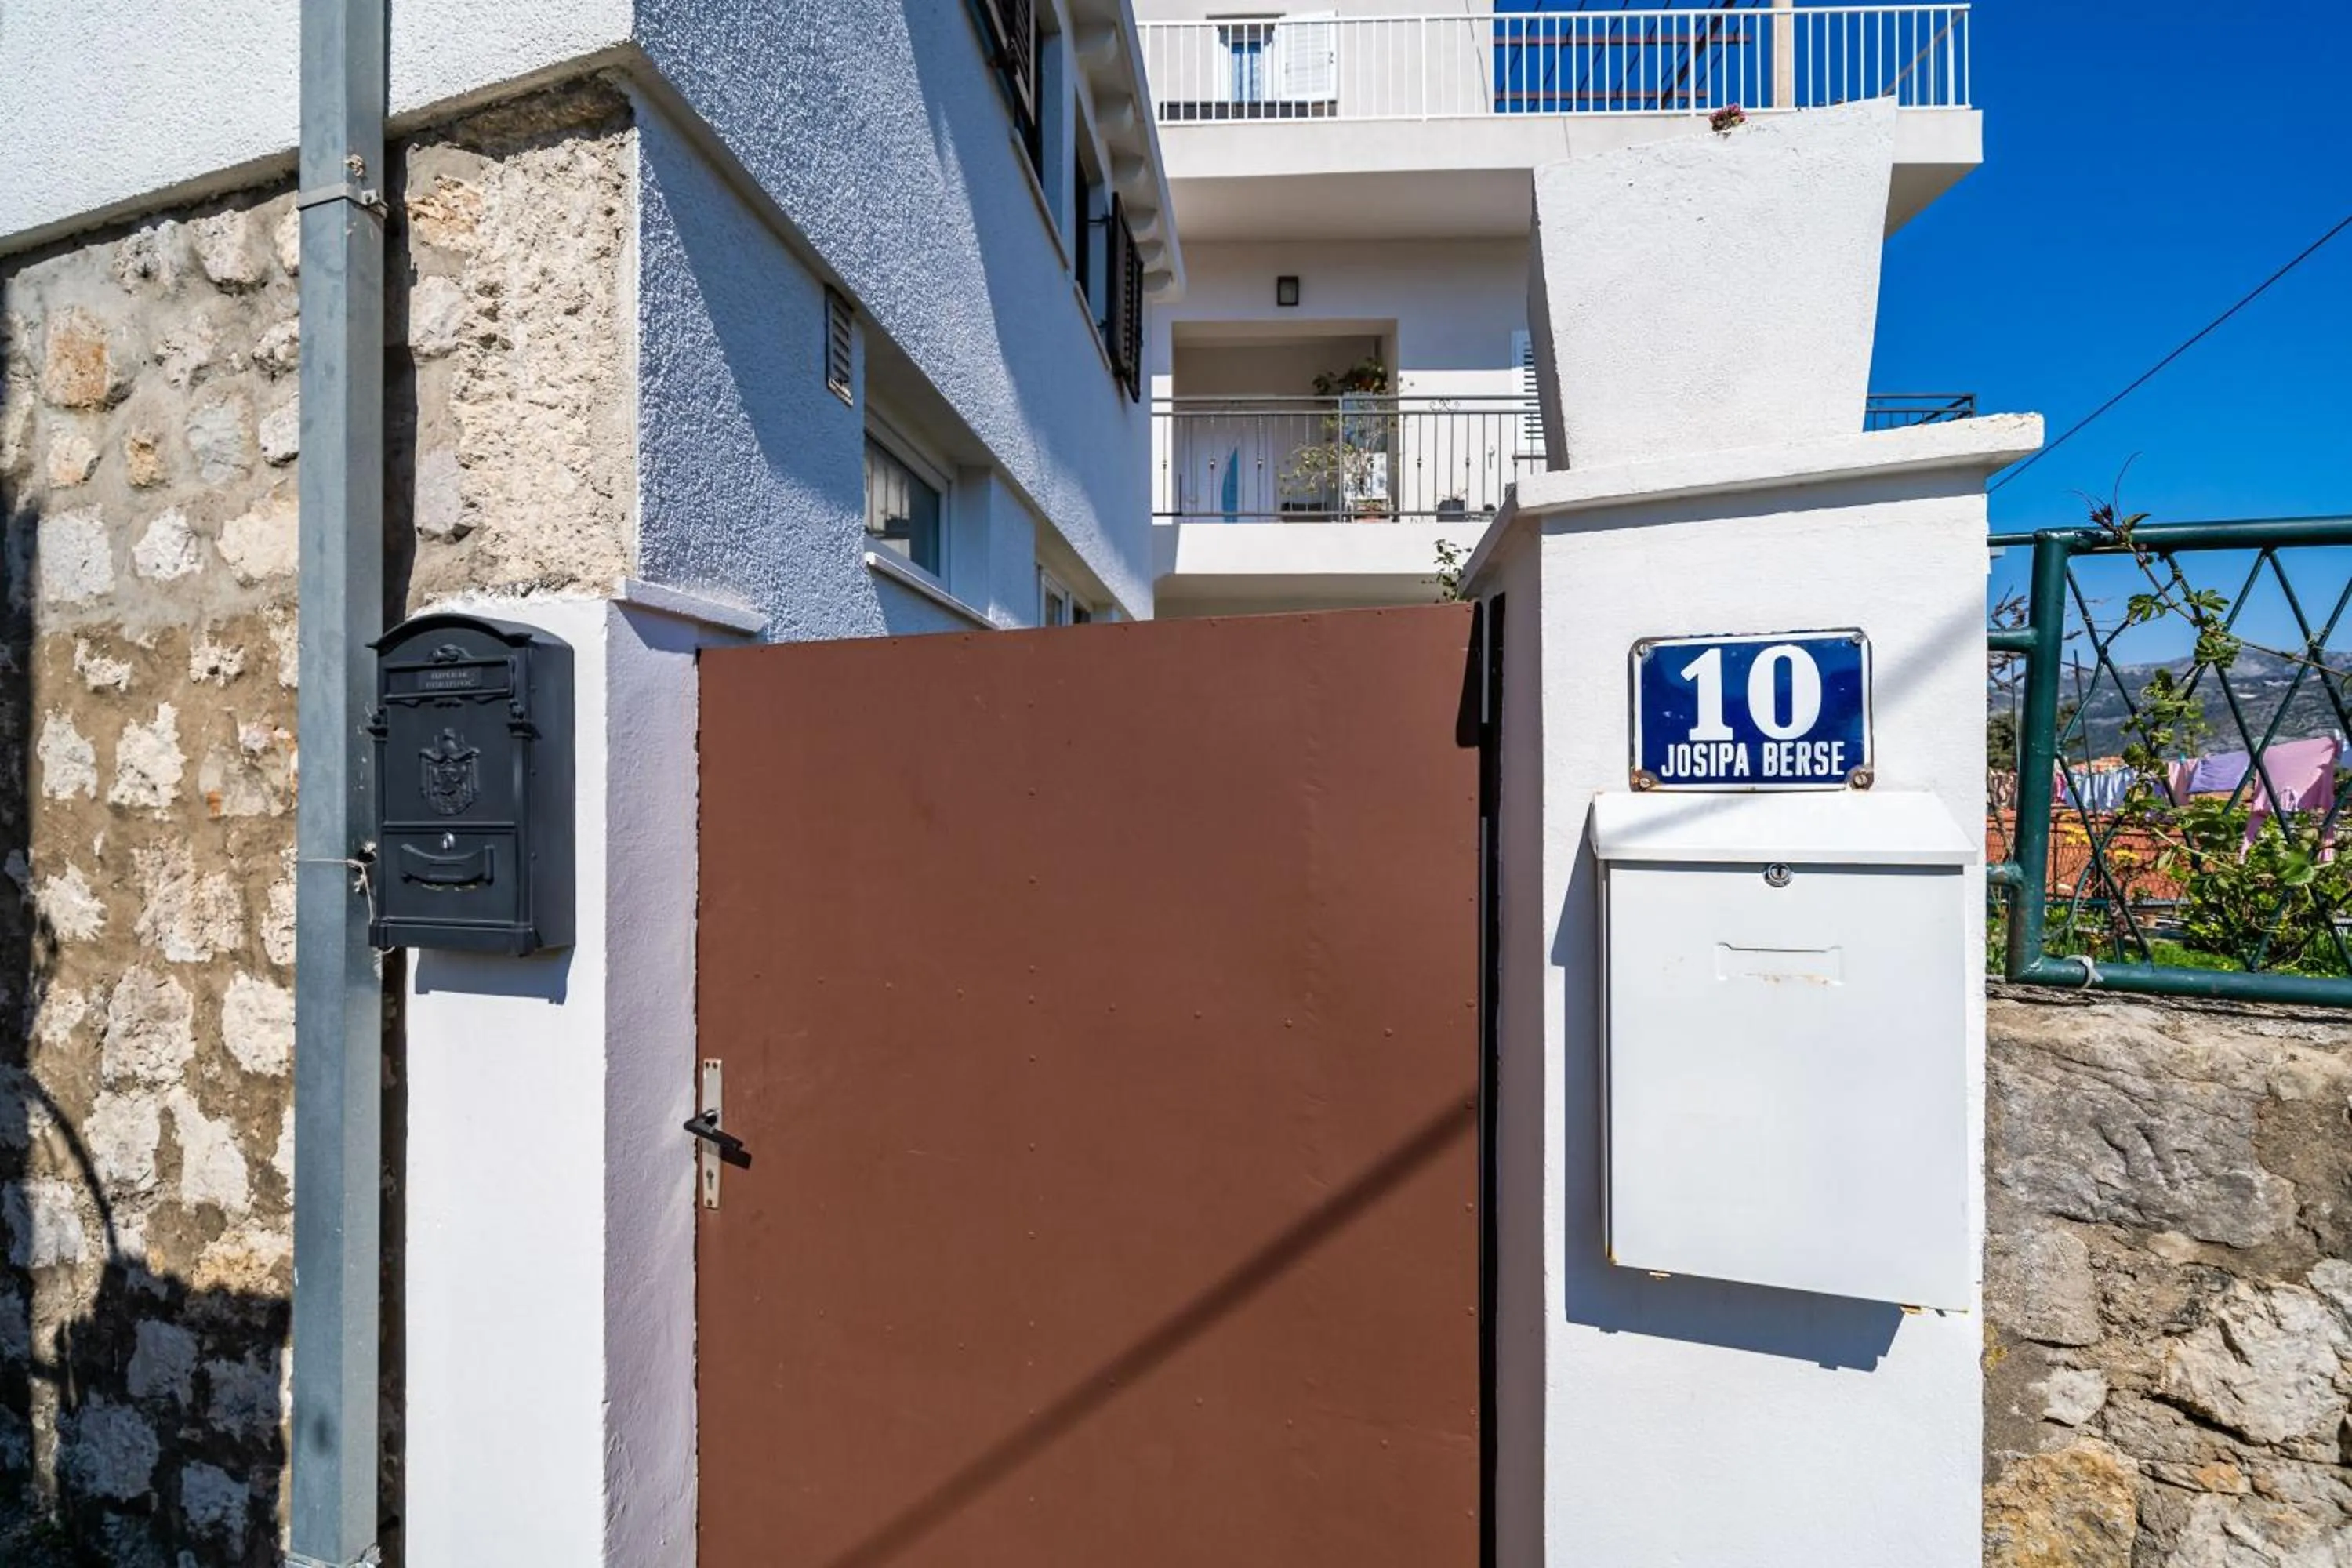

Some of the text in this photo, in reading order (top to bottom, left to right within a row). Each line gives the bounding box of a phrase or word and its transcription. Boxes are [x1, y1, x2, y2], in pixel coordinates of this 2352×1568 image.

[1680, 644, 1821, 741] 10
[1661, 741, 1845, 777] JOSIPA BERSE
